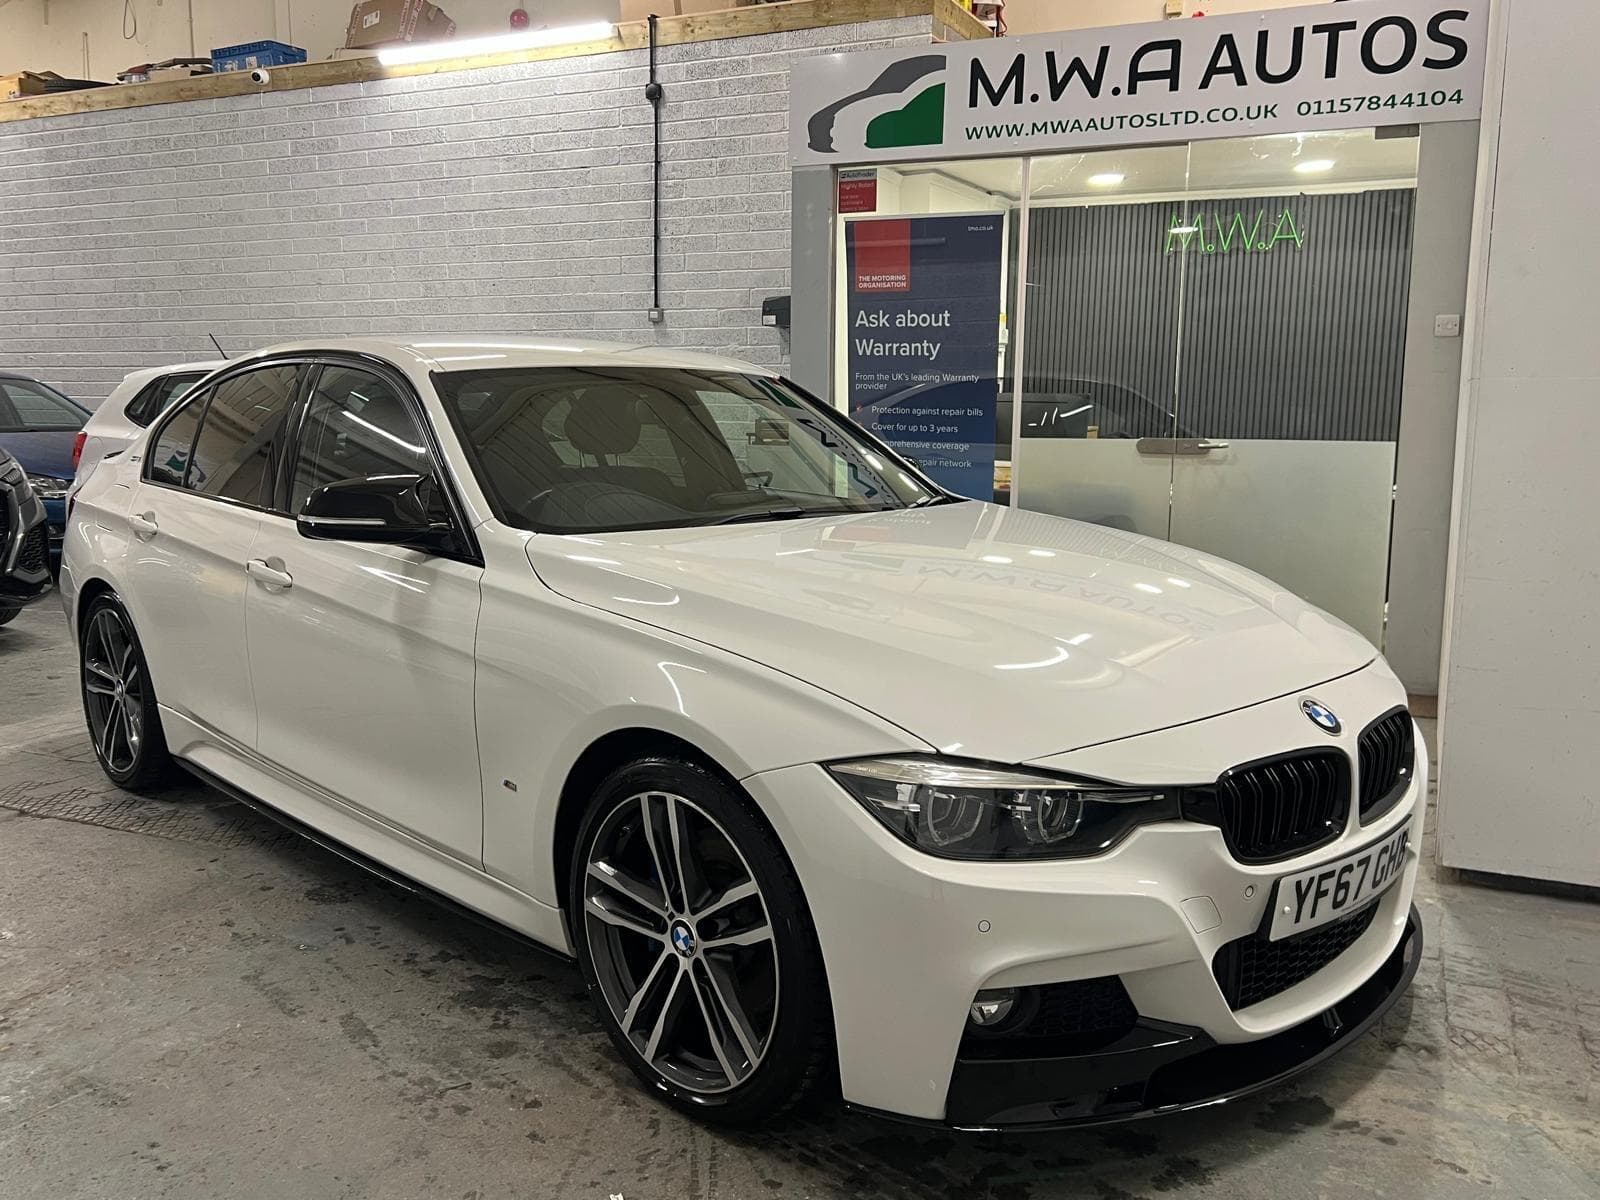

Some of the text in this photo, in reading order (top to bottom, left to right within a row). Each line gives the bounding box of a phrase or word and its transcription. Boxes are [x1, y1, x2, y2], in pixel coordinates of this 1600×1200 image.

[967, 9, 1470, 109] M.W.A AUTOS
[965, 89, 1464, 140] WWW.MWAAUTOSLTD.CO.UK 01157844104
[858, 281, 907, 289] ORGANISATION
[855, 309, 951, 328] Ask about
[855, 338, 941, 361] Warranty
[855, 373, 980, 383] From the UK's leading Warranty
[855, 382, 888, 391] provider
[871, 405, 984, 417] Protection against repair bills
[871, 422, 959, 434] Cover for up to 3 years
[885, 440, 970, 453] prehensive coverage
[939, 459, 972, 468] network
[1294, 855, 1371, 924] YF67
